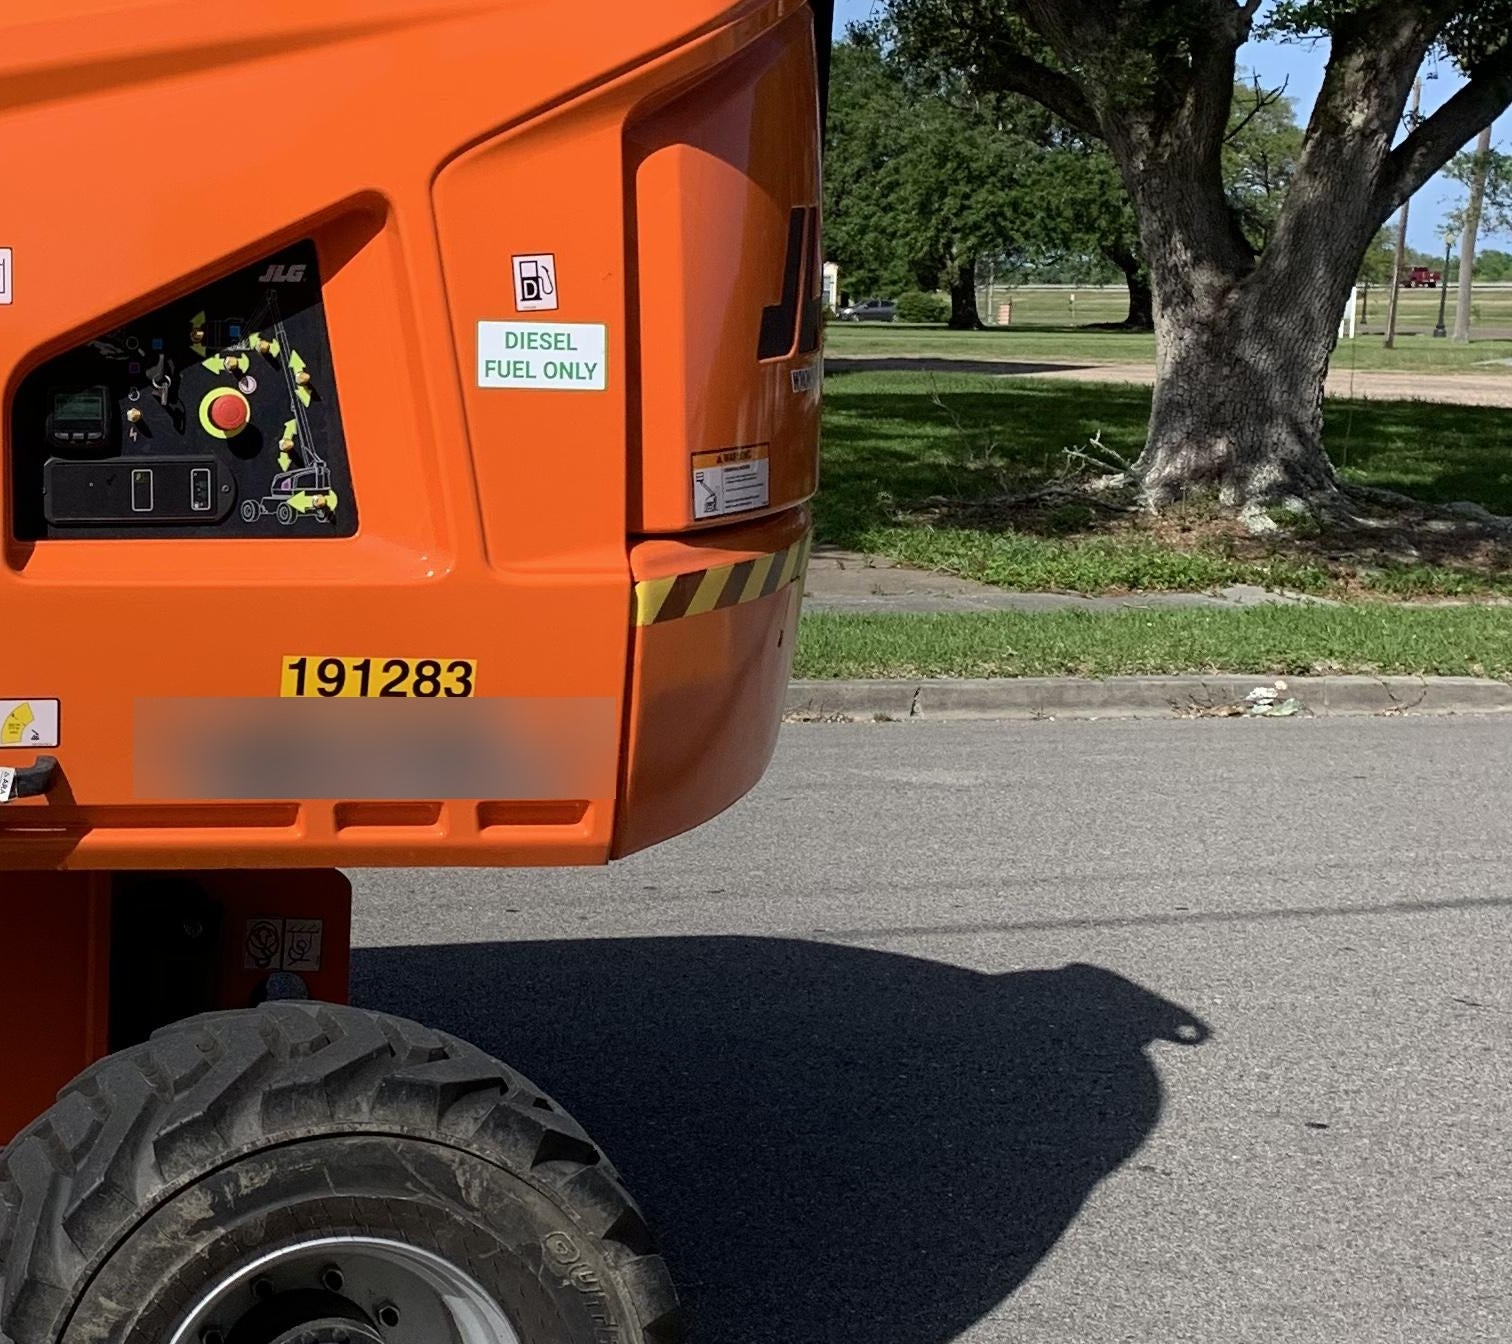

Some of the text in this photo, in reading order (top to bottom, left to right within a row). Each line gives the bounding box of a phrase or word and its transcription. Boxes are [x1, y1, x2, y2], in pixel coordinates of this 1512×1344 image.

[258, 264, 307, 283] JLG
[504, 331, 578, 351] DIESEL
[485, 359, 597, 380] FUEL ONLY
[287, 657, 473, 697] 191283
